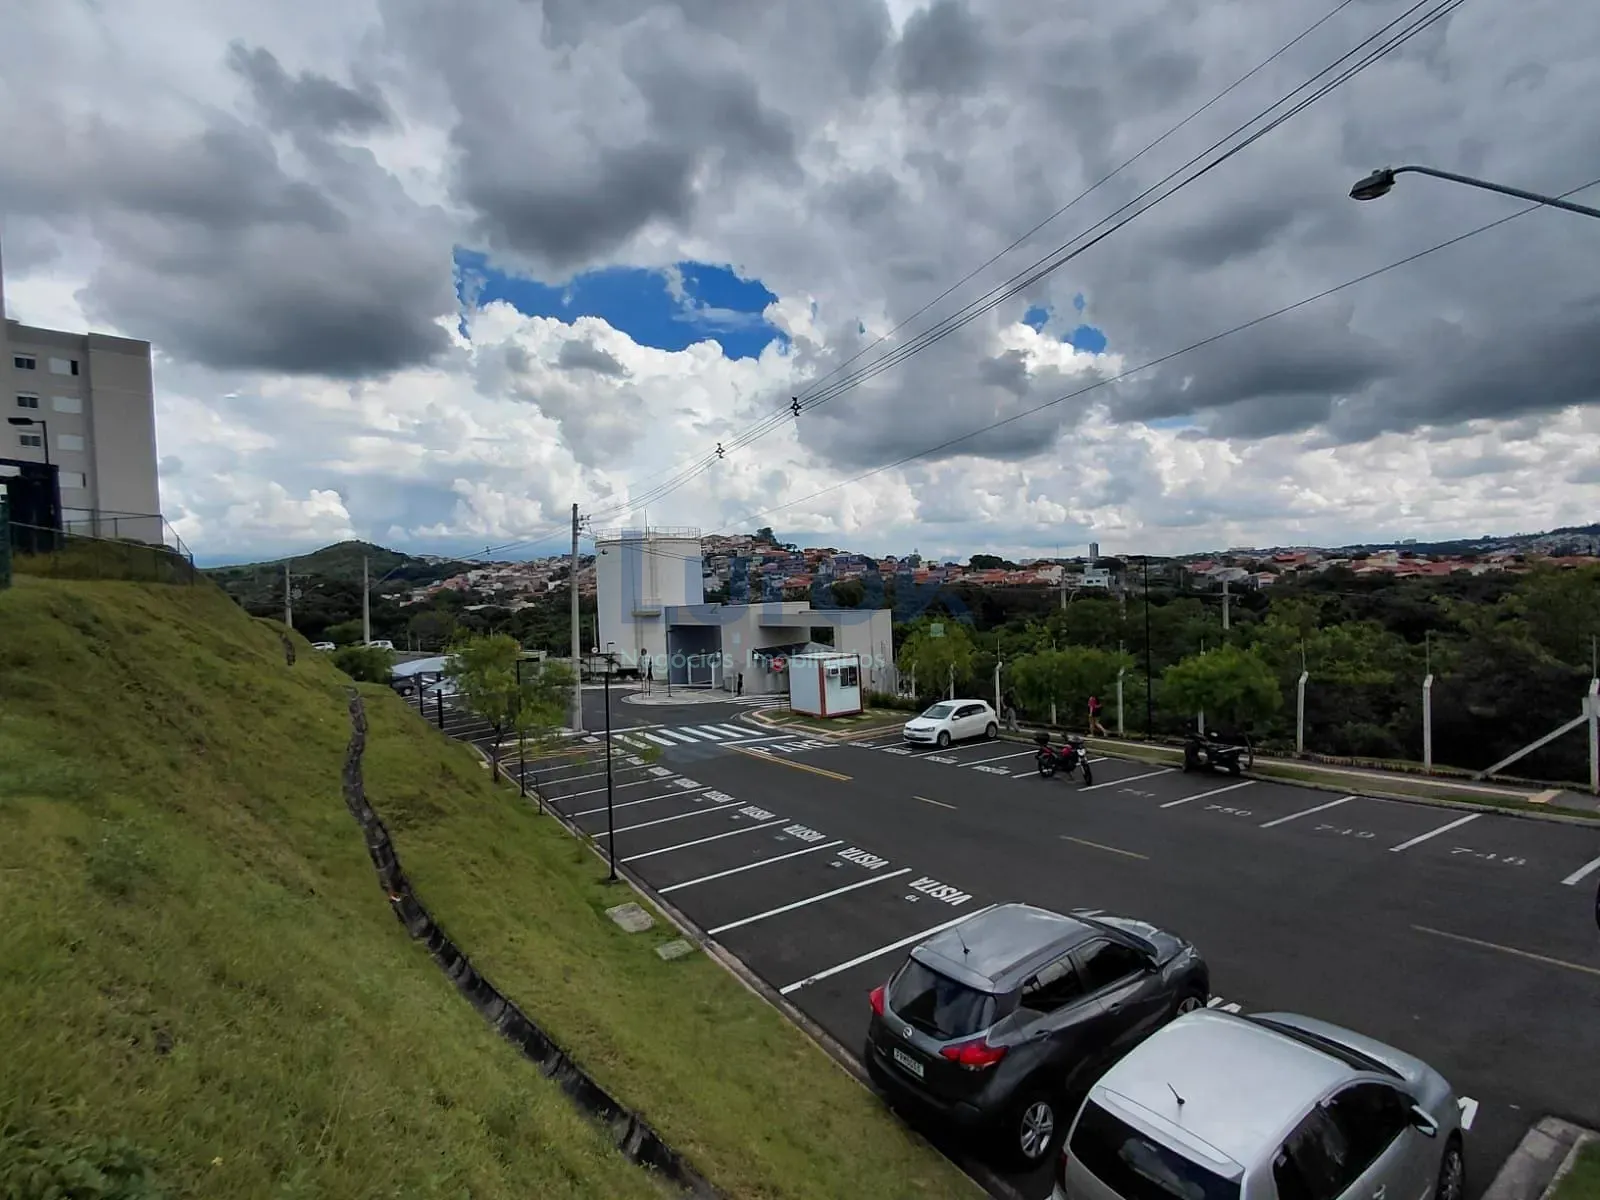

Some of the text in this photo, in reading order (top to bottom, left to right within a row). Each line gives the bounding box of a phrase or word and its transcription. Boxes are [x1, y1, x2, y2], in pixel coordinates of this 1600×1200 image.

[1204, 804, 1252, 817] 750
[837, 846, 890, 870] VISITA
[908, 876, 973, 906] VISITA
